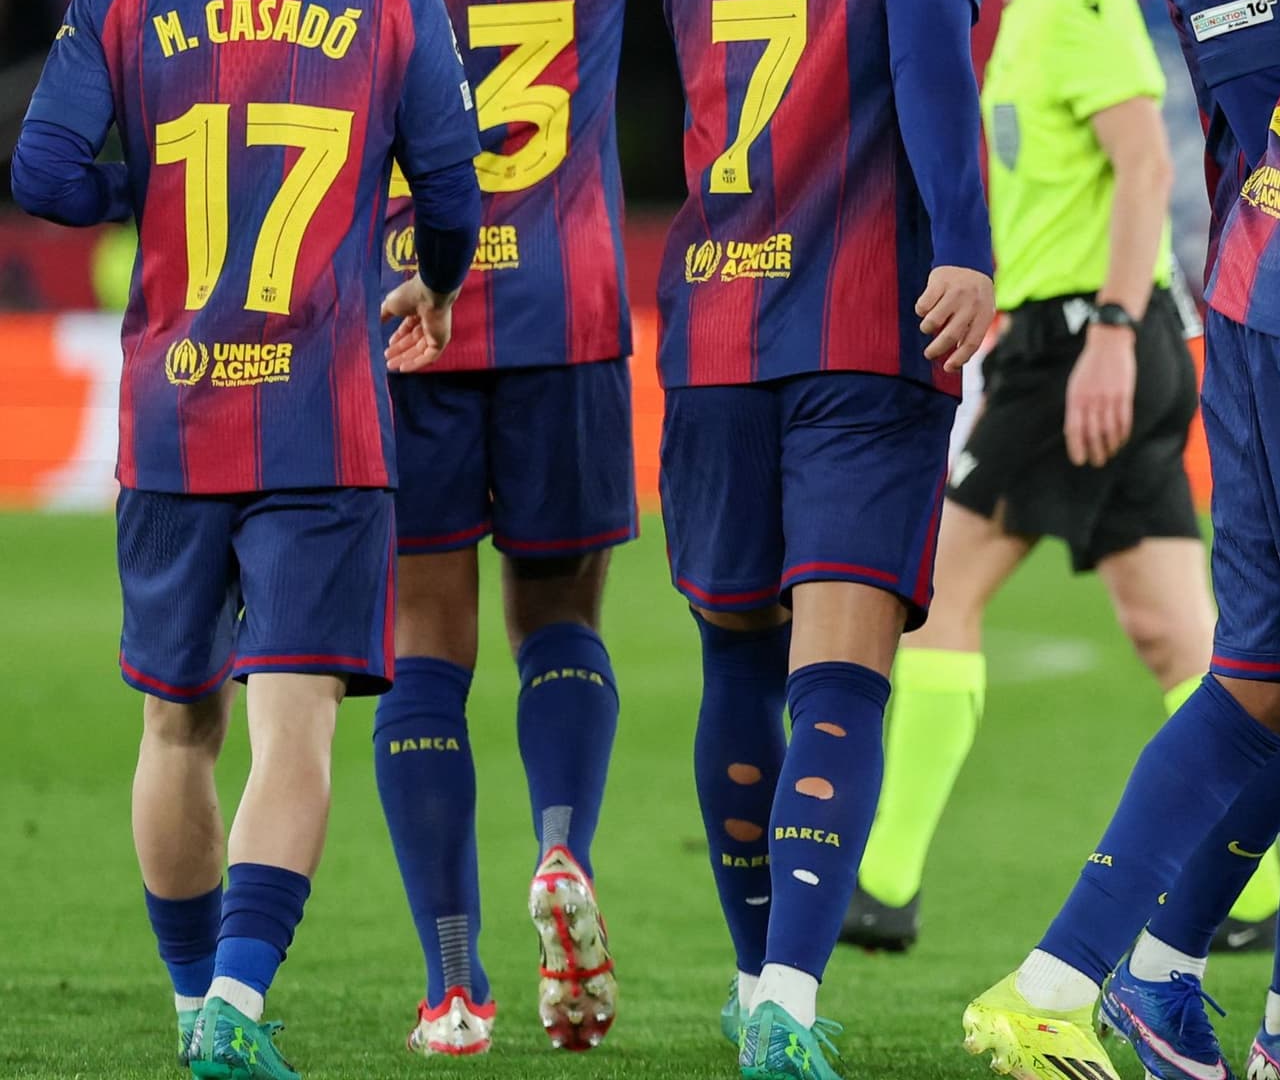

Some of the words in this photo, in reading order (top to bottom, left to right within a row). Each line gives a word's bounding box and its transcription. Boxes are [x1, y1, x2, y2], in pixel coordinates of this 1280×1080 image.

[1247, 1, 1268, 16] 10
[153, 10, 199, 57] M.
[155, 103, 355, 315] 17
[213, 342, 293, 361] UNHCR
[211, 357, 290, 380] ACNUR
[775, 826, 840, 848] BARÇA
